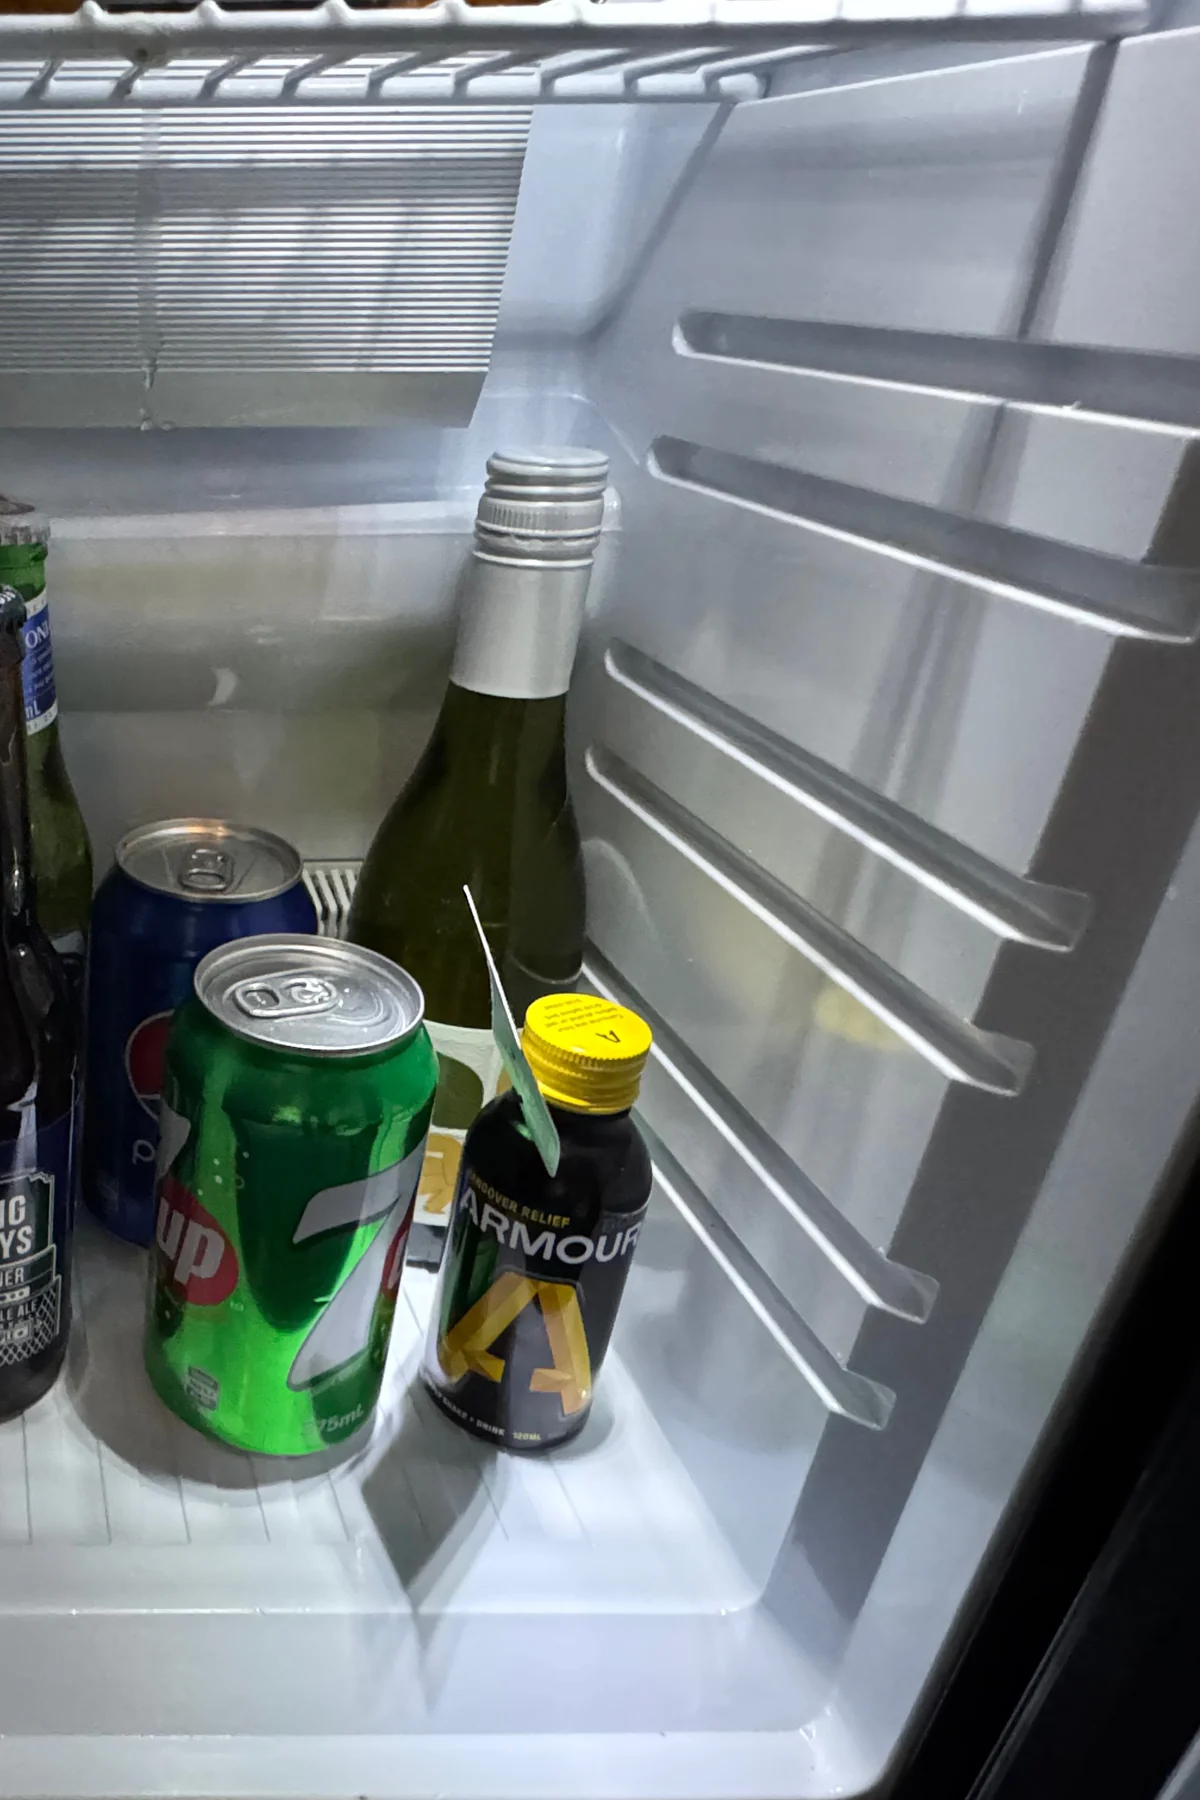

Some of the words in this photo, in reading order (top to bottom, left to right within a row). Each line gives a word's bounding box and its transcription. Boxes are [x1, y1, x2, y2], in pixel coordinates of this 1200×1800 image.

[468, 1170, 518, 1213] ANGOVER
[520, 1205, 571, 1229] RELIEF
[461, 1188, 642, 1265] ARMOUR
[17, 1301, 38, 1317] ALE
[476, 1418, 506, 1437] DRINK
